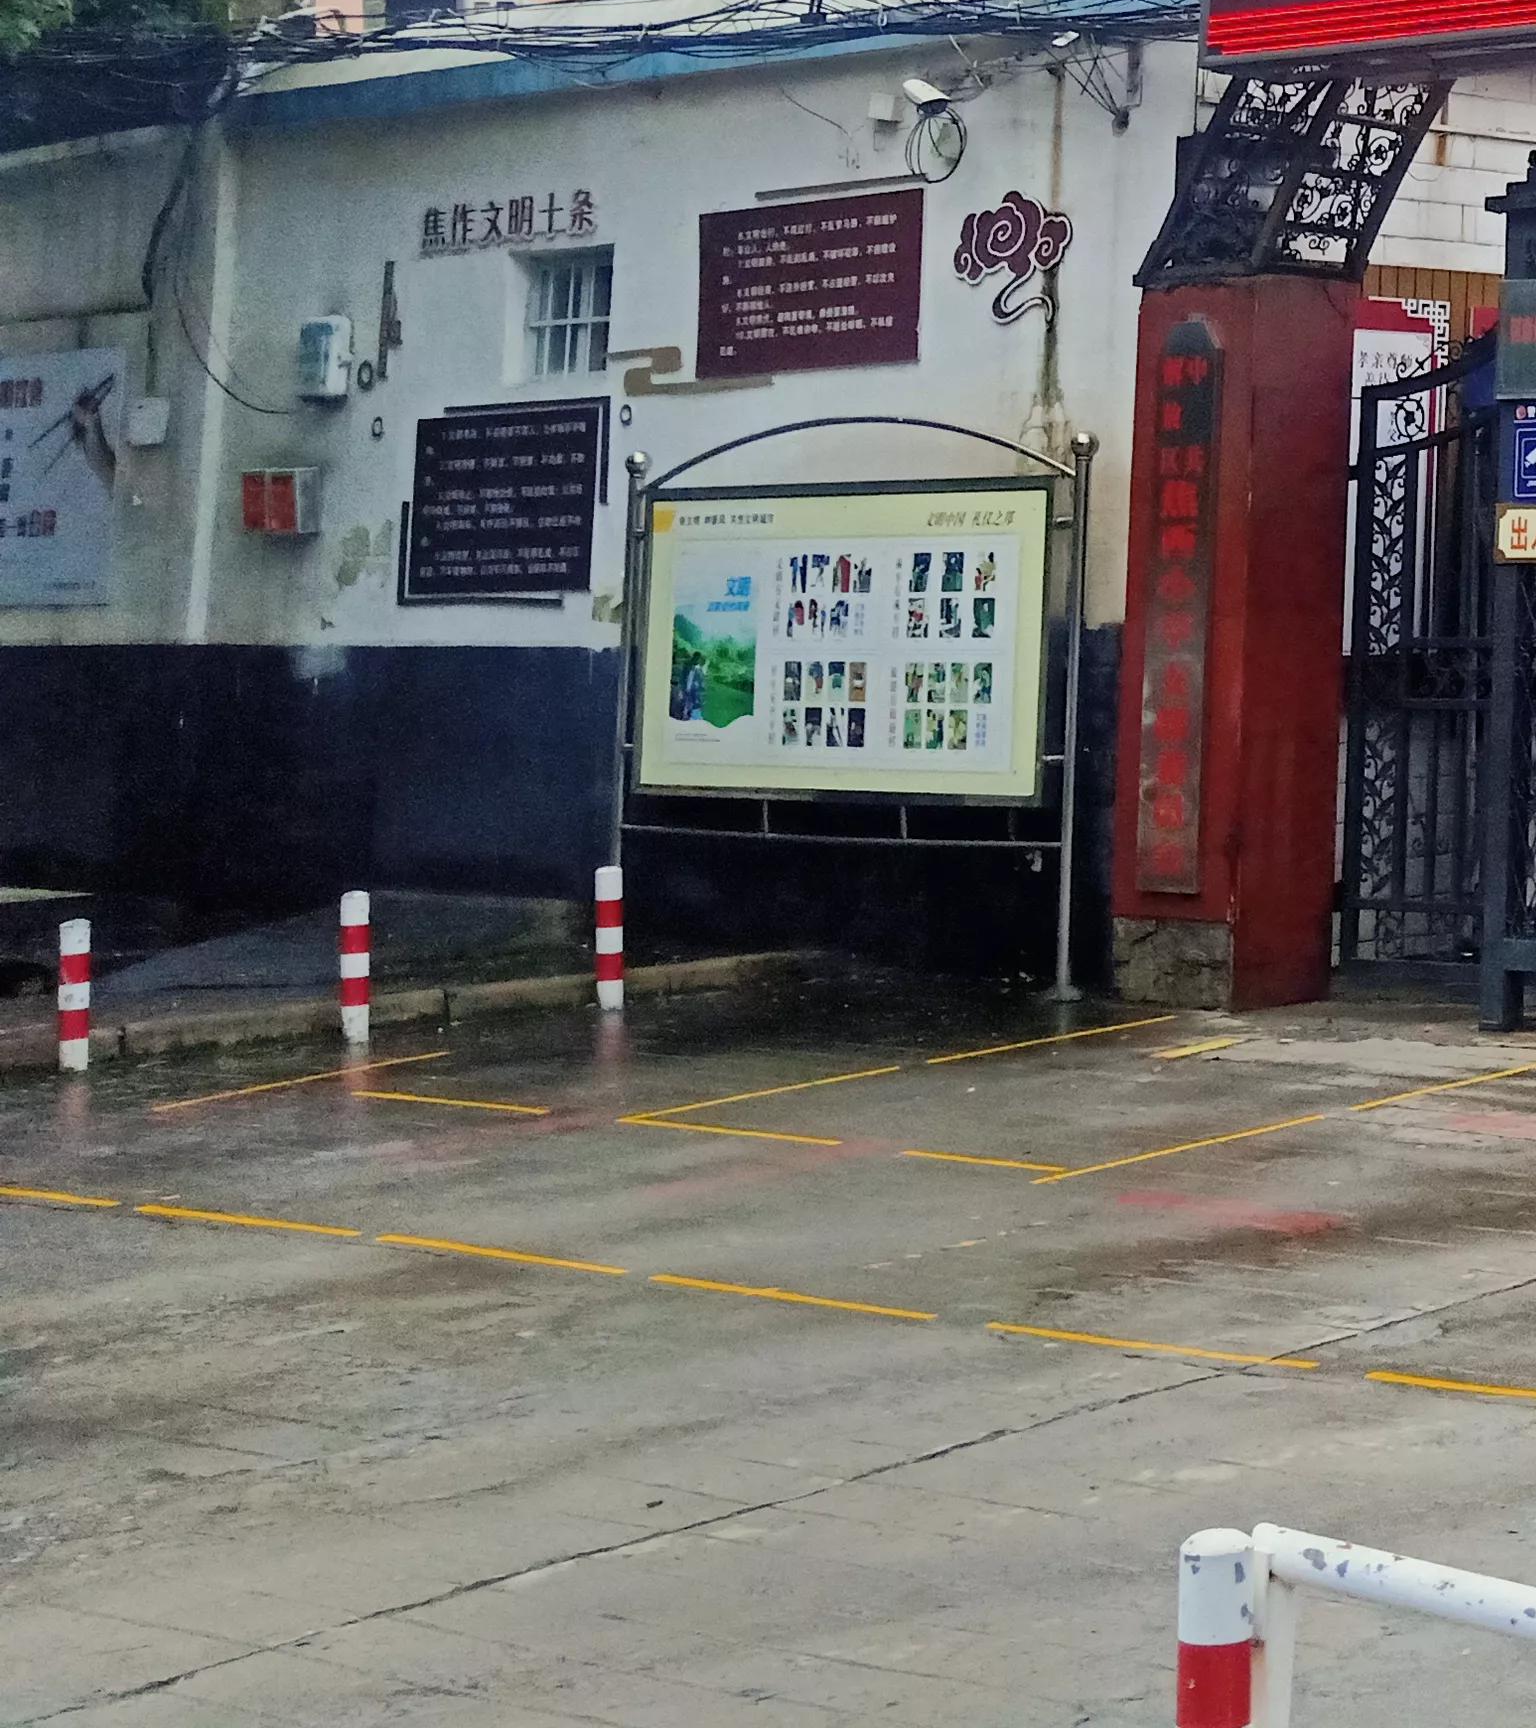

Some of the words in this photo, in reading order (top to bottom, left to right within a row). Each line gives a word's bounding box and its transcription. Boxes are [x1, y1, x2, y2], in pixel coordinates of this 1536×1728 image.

[421, 189, 595, 250] 焦作文明十条
